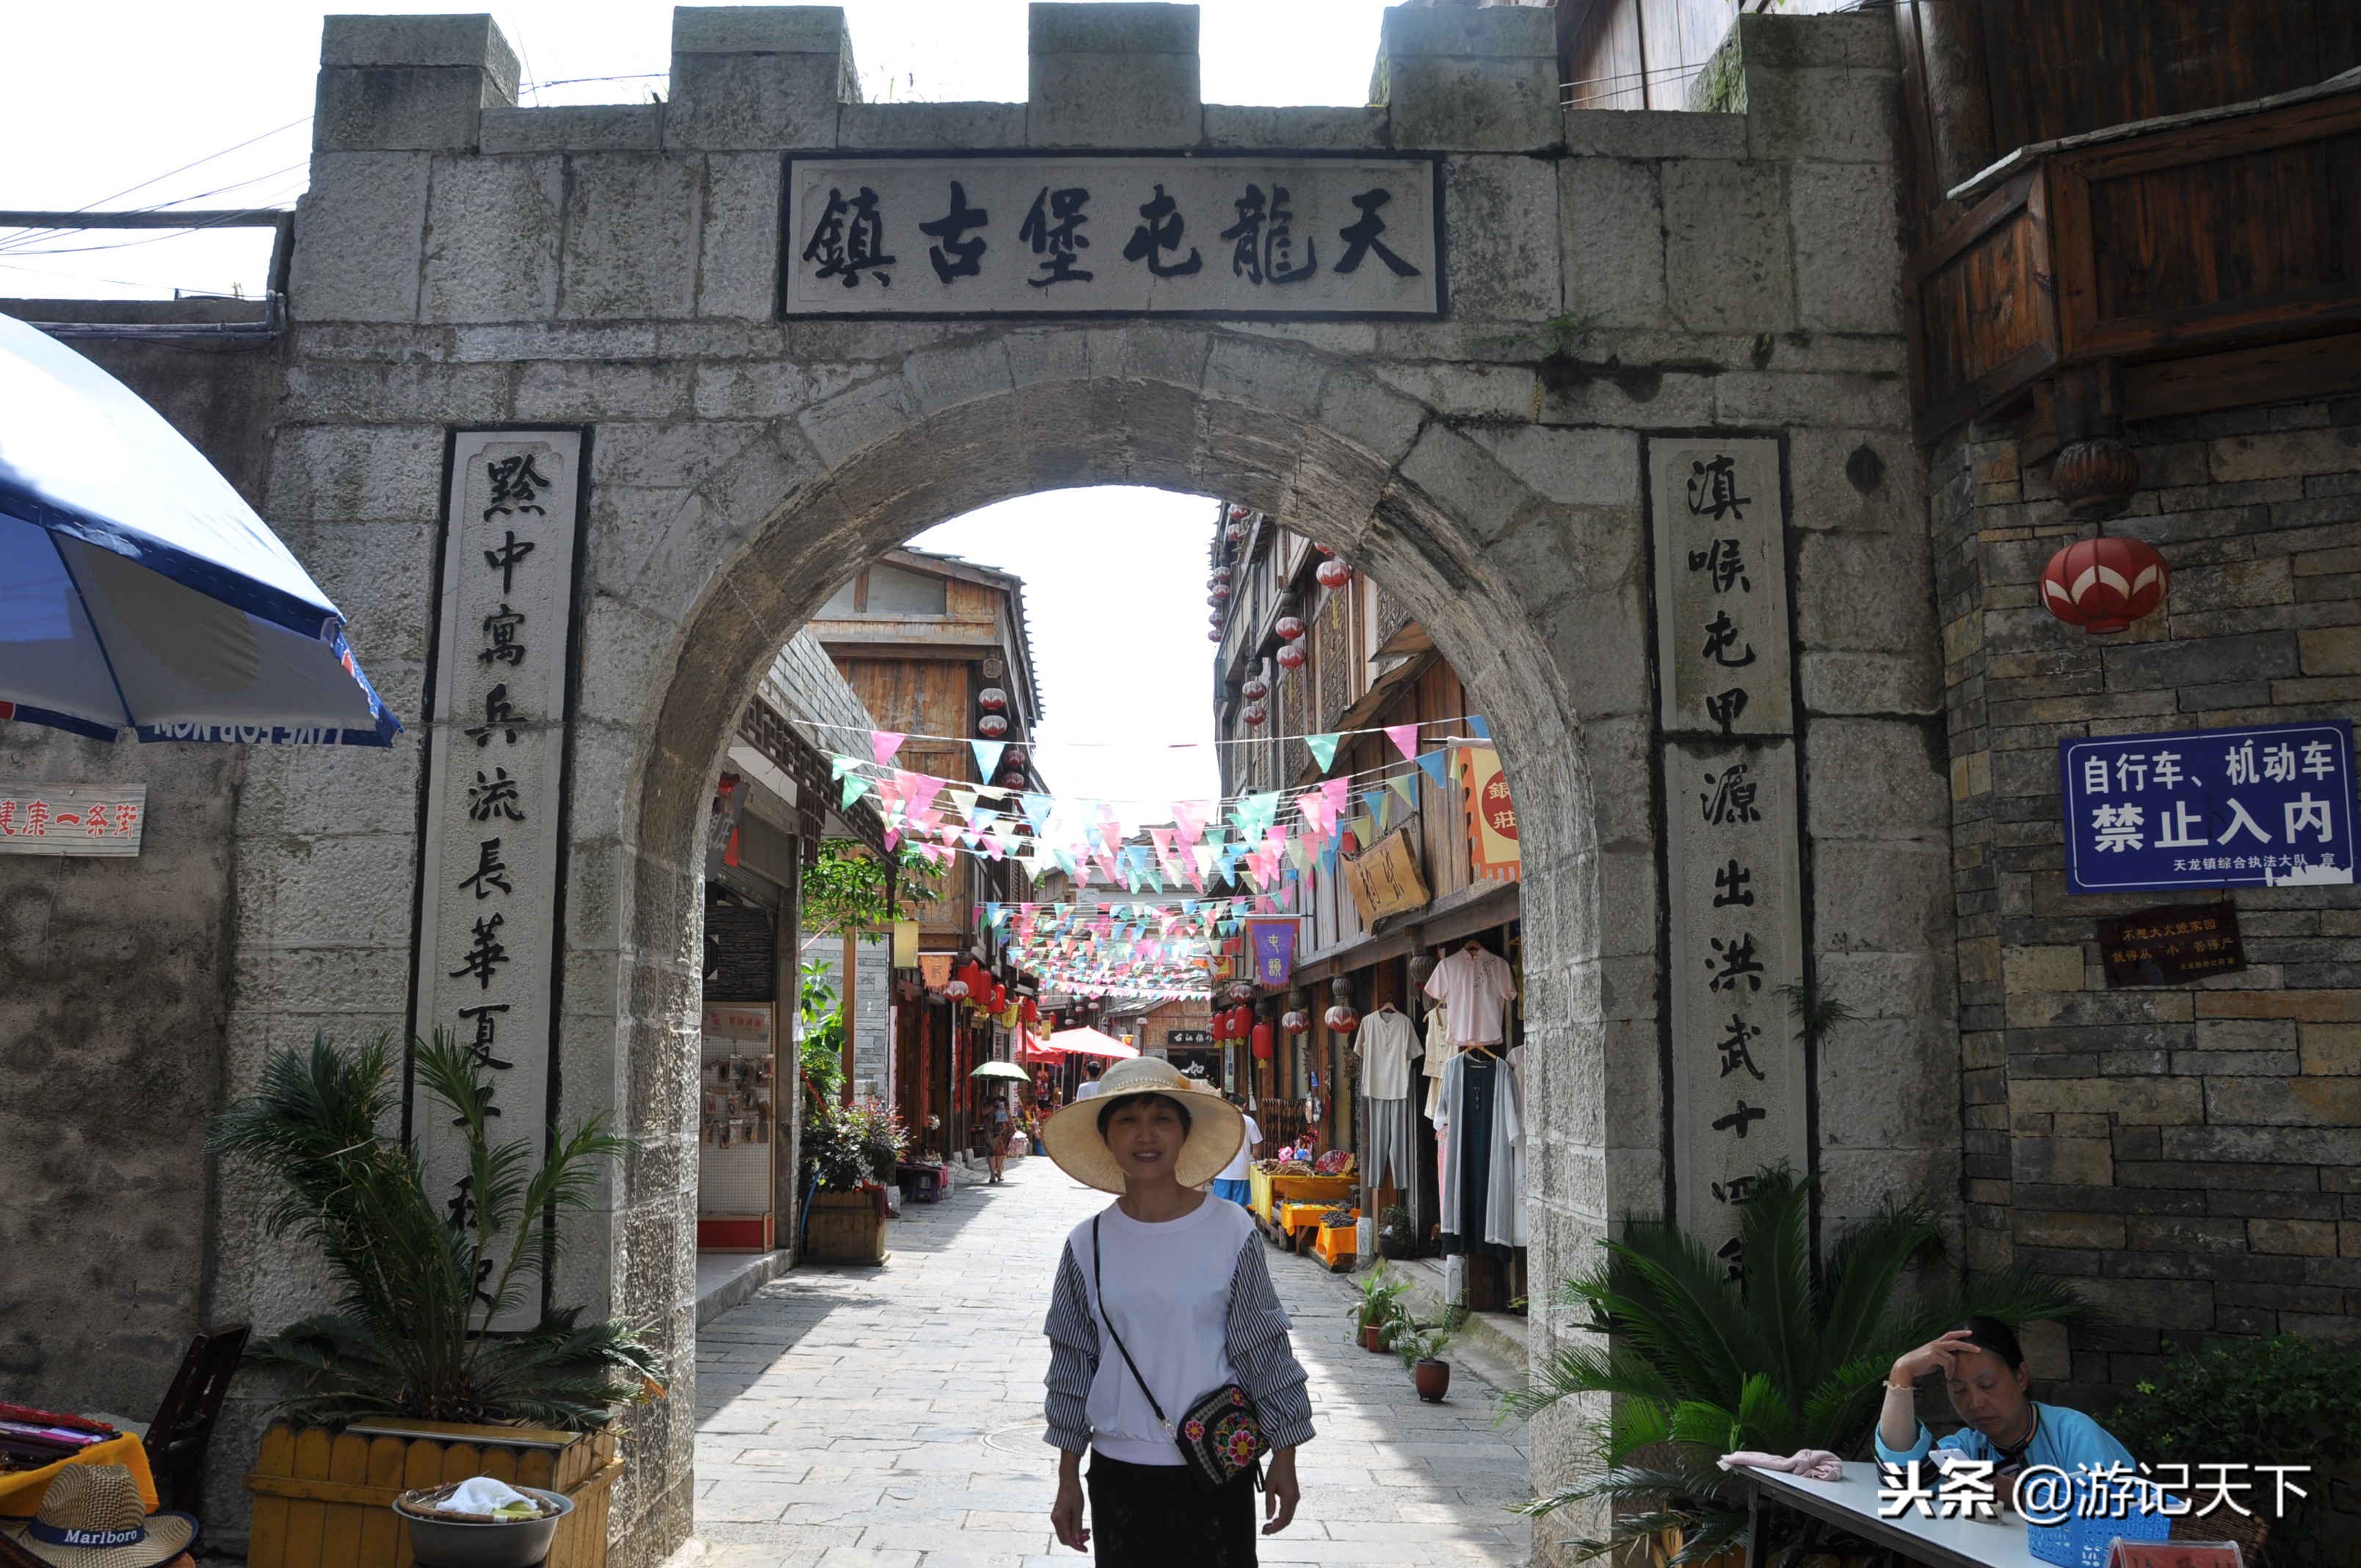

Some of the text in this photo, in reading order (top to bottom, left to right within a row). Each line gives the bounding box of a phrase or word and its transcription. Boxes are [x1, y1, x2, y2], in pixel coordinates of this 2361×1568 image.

[2084, 738, 2335, 795] 自行车、机动车
[2092, 791, 2333, 853] 禁止入内
[64, 1528, 138, 1545] Marlboro
